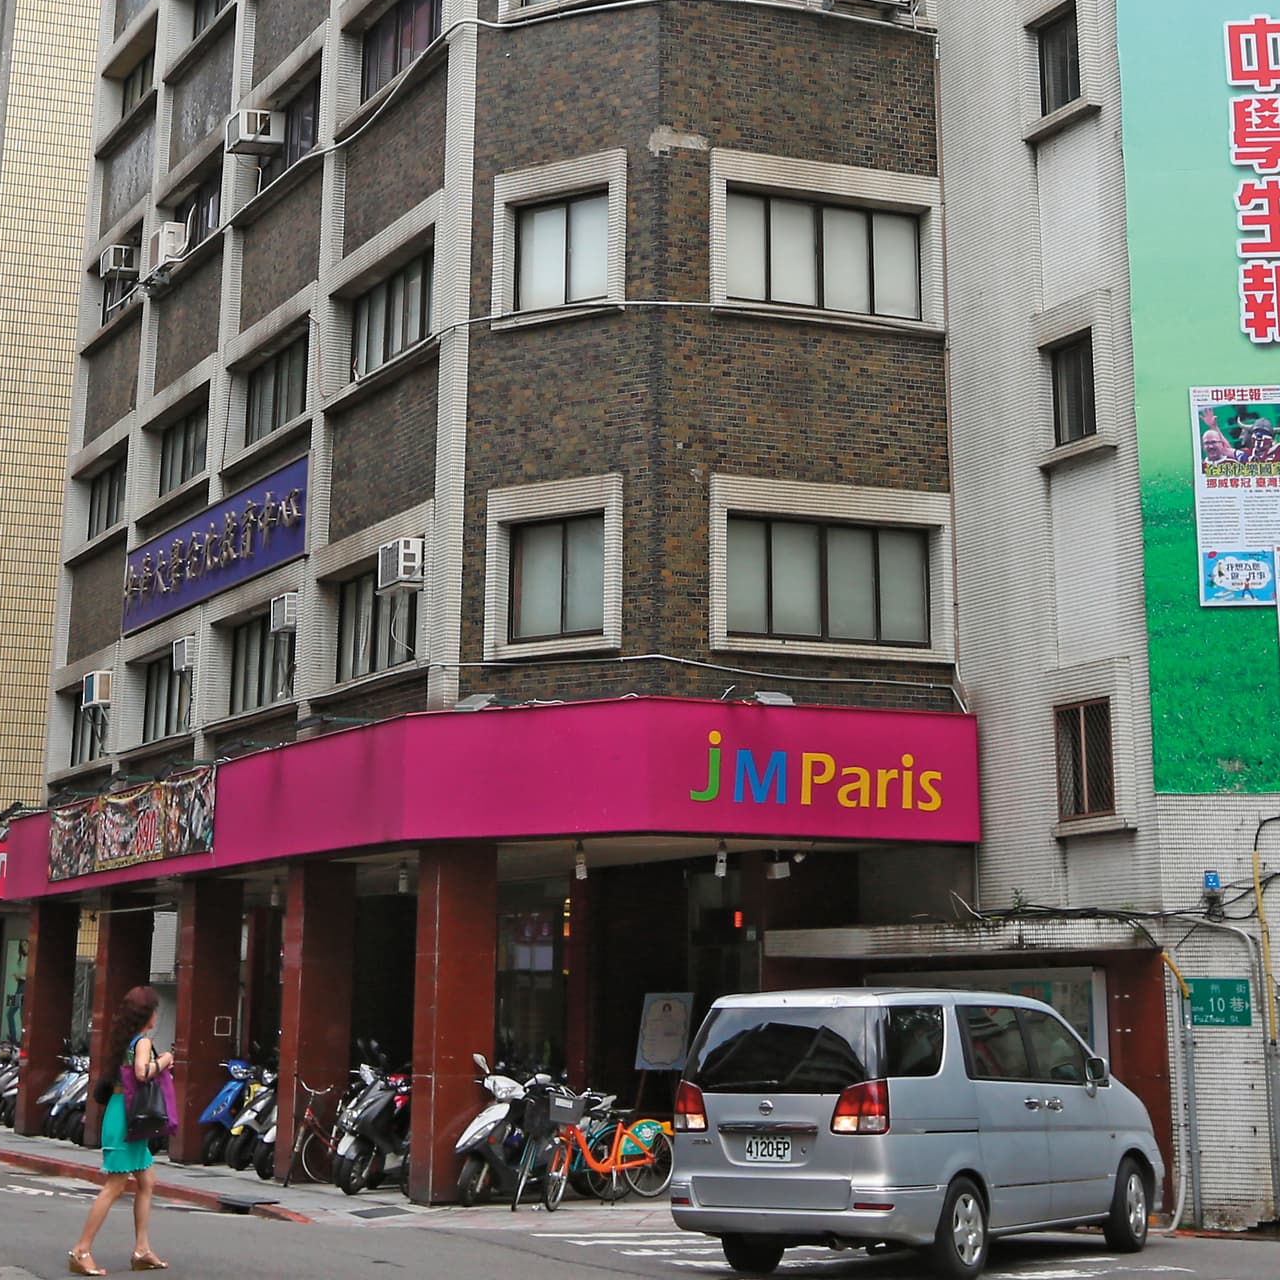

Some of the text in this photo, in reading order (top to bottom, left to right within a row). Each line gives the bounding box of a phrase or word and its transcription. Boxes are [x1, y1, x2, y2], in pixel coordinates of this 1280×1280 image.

[1211, 387, 1261, 402] 中學生報
[1209, 997, 1225, 1012] 10
[1229, 996, 1245, 1012] 巷
[746, 1140, 790, 1158] 4120-EP
